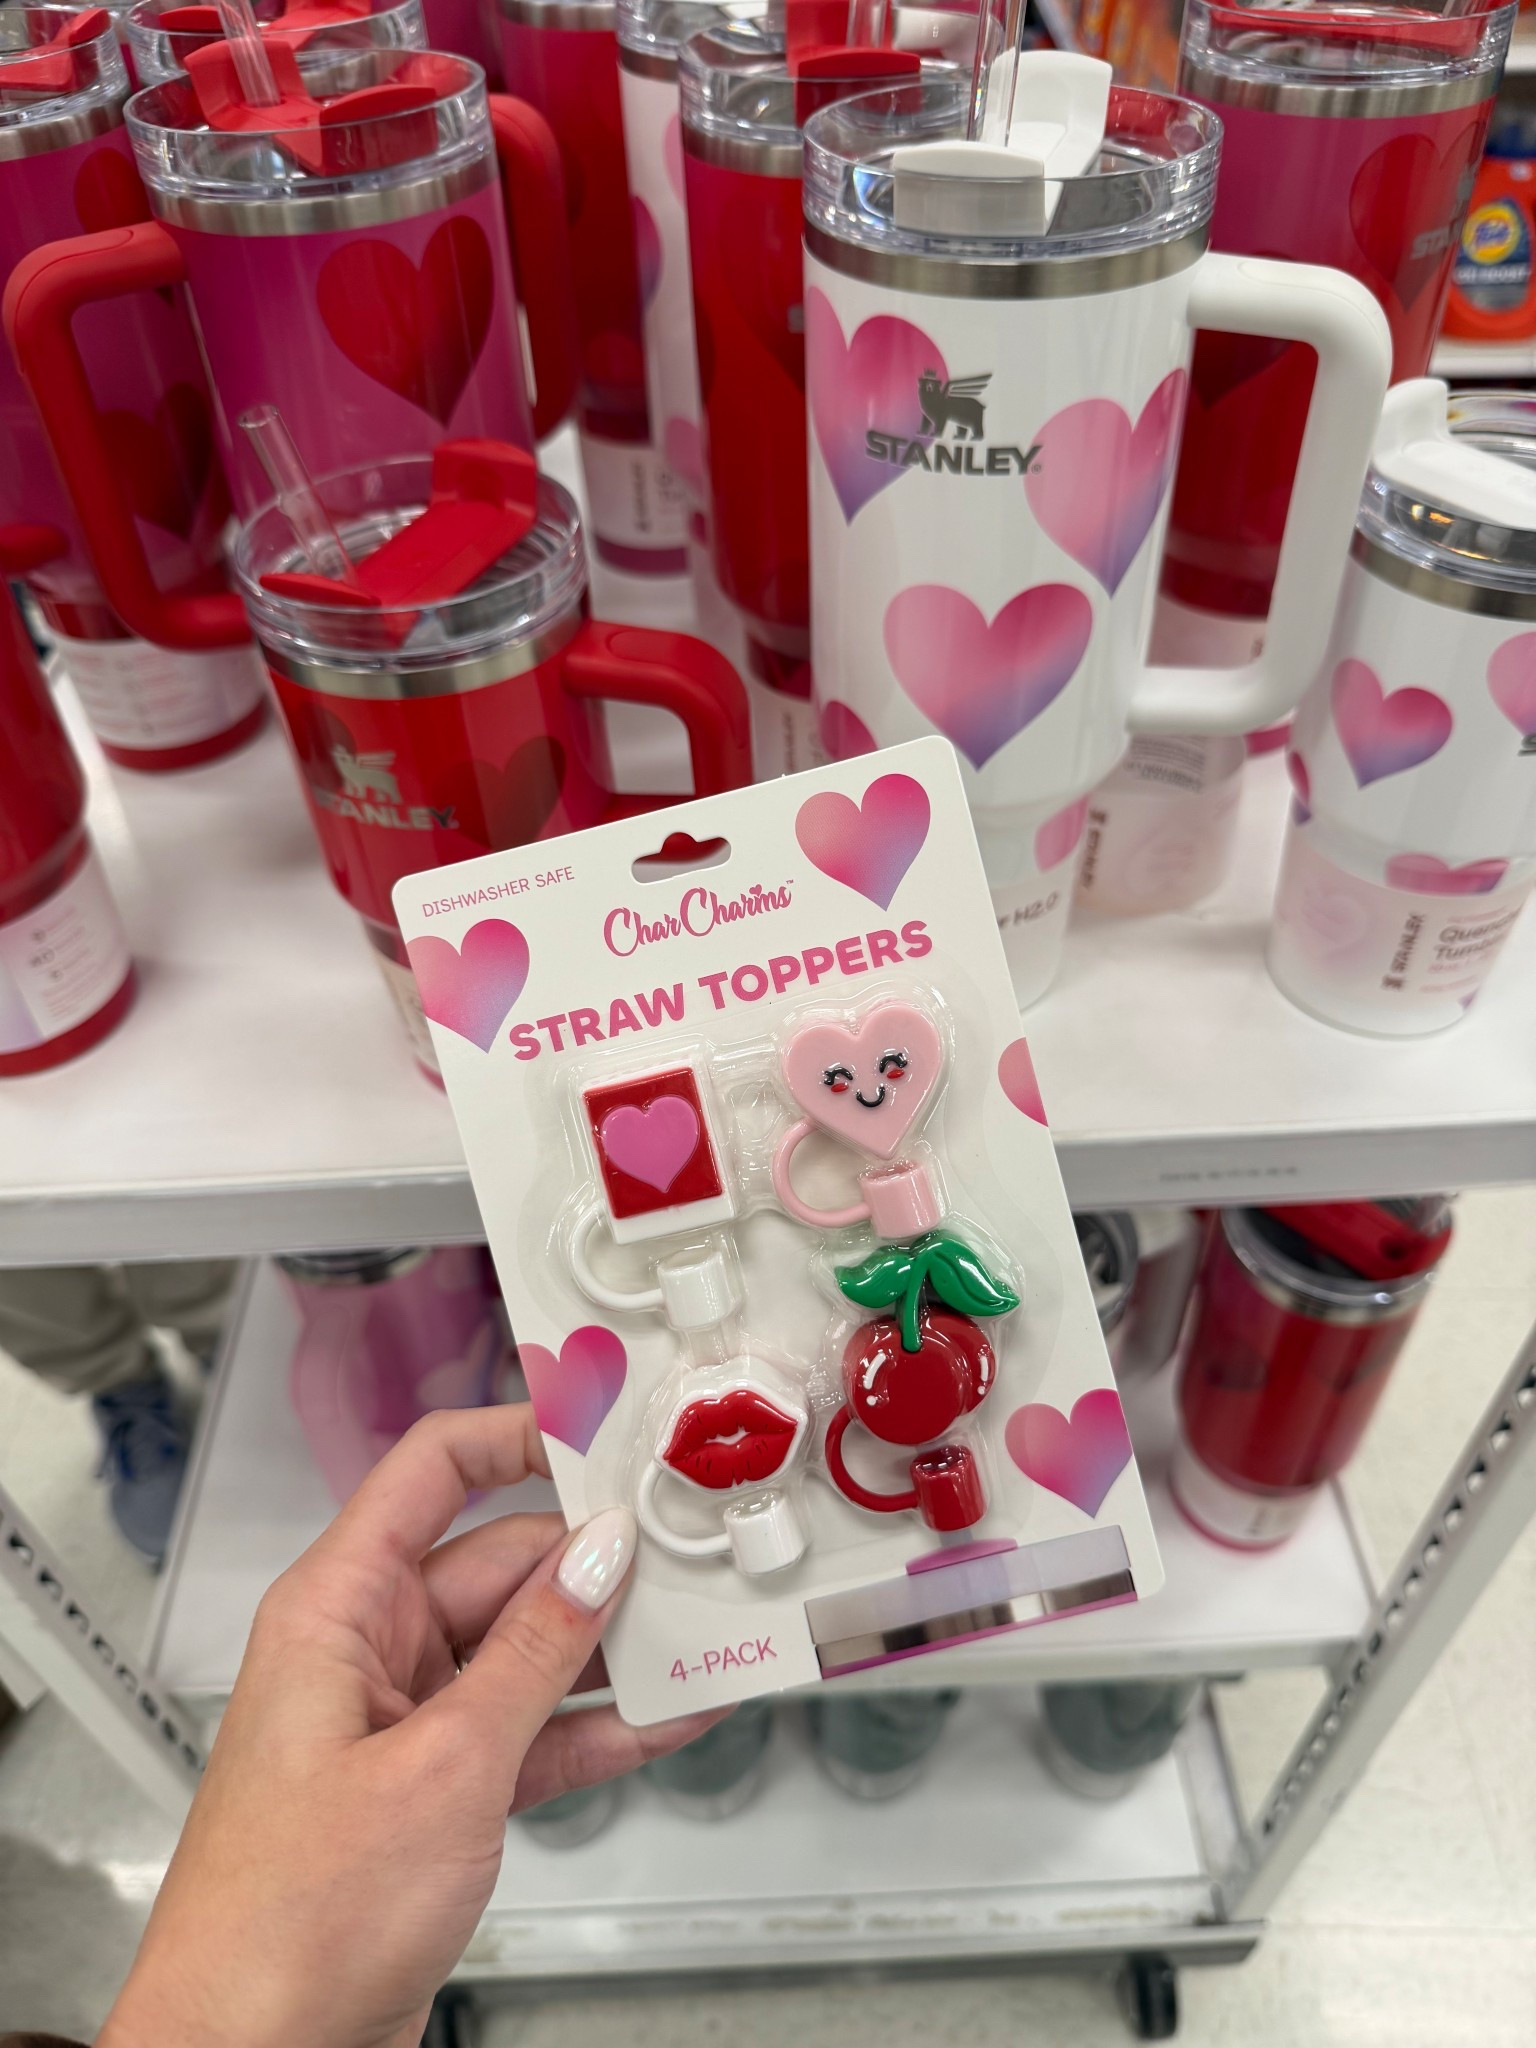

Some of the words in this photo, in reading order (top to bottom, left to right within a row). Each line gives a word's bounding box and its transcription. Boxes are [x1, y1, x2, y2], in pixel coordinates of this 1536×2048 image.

[422, 878, 531, 918] DISHWASHER
[534, 866, 575, 888] SAFE
[509, 982, 685, 1061] STRAW
[698, 920, 933, 1010] TOPPERS
[670, 1636, 778, 1681] 4-PACK
